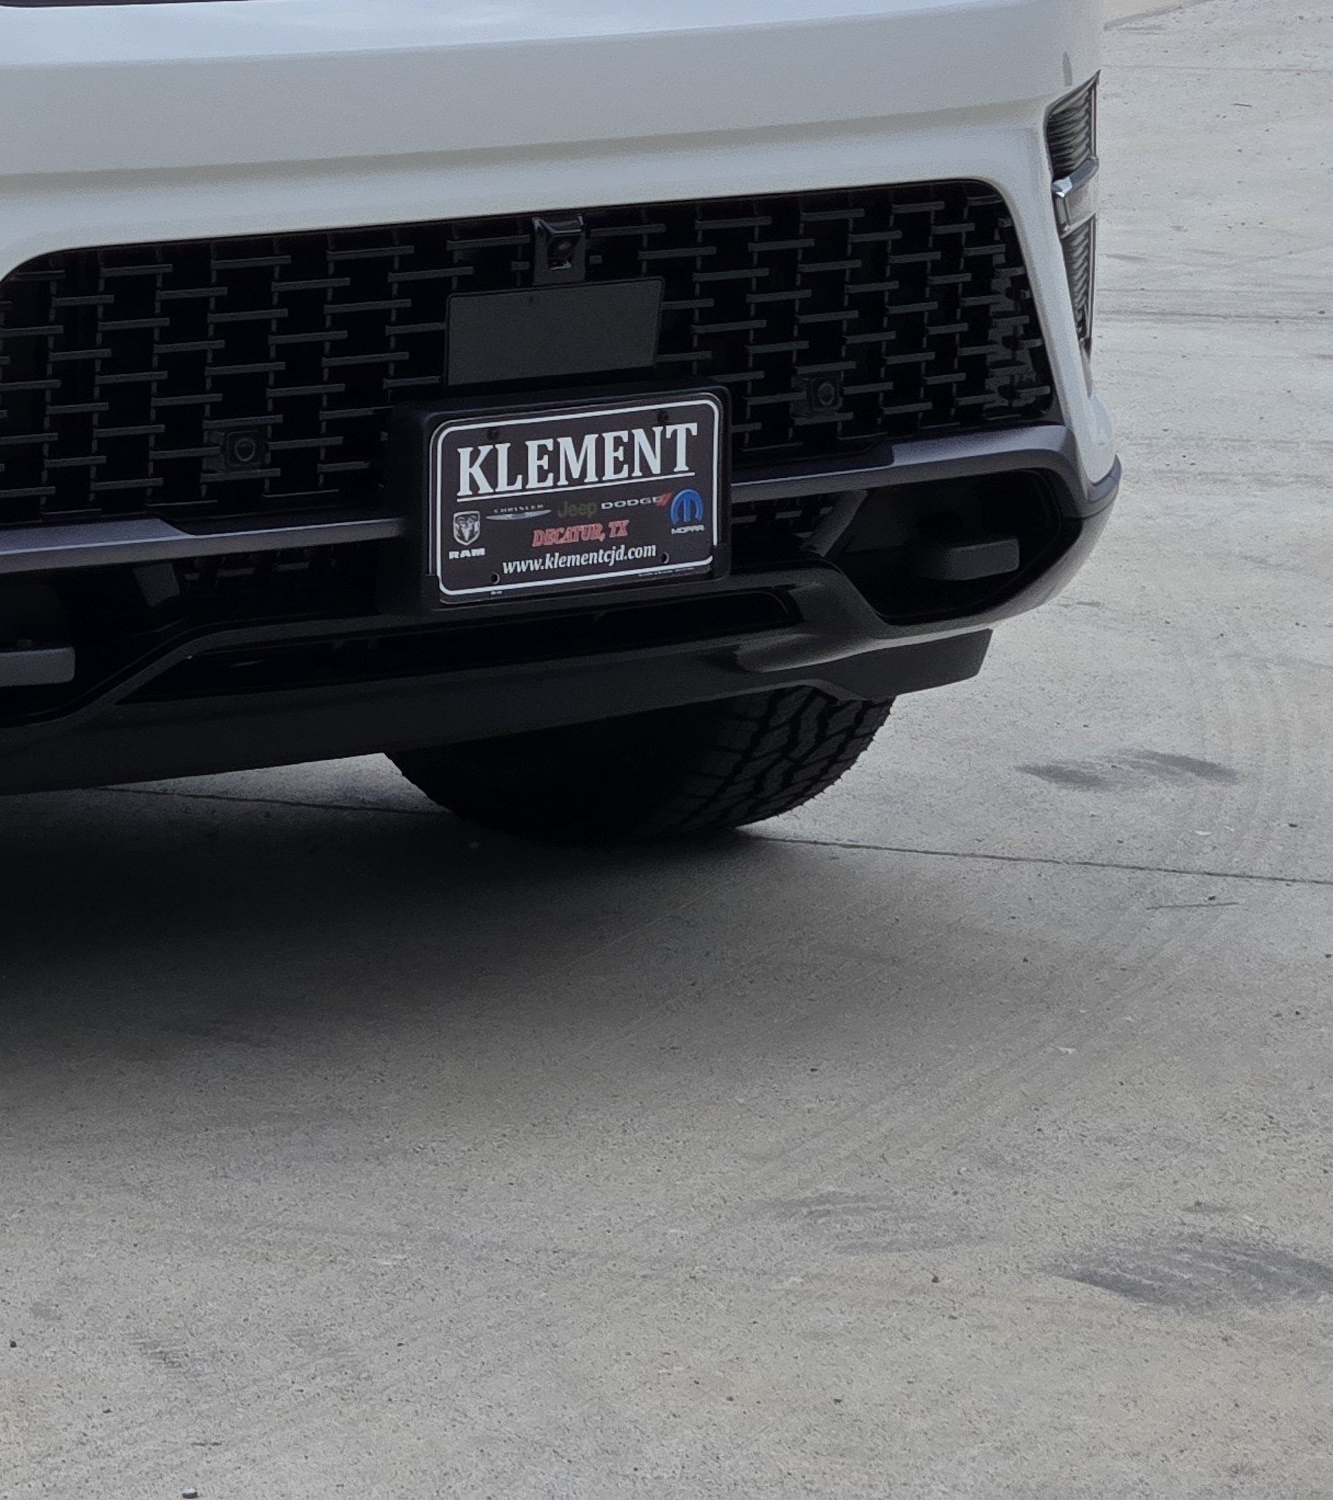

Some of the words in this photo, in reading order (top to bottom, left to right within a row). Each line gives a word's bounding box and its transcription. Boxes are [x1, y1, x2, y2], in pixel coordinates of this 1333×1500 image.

[456, 422, 698, 496] KLEMENT
[557, 501, 597, 518] Jeep
[601, 496, 664, 510] DODGE
[608, 519, 630, 538] TX
[448, 548, 485, 559] RAM
[502, 544, 657, 575] www.klementcjd.com
